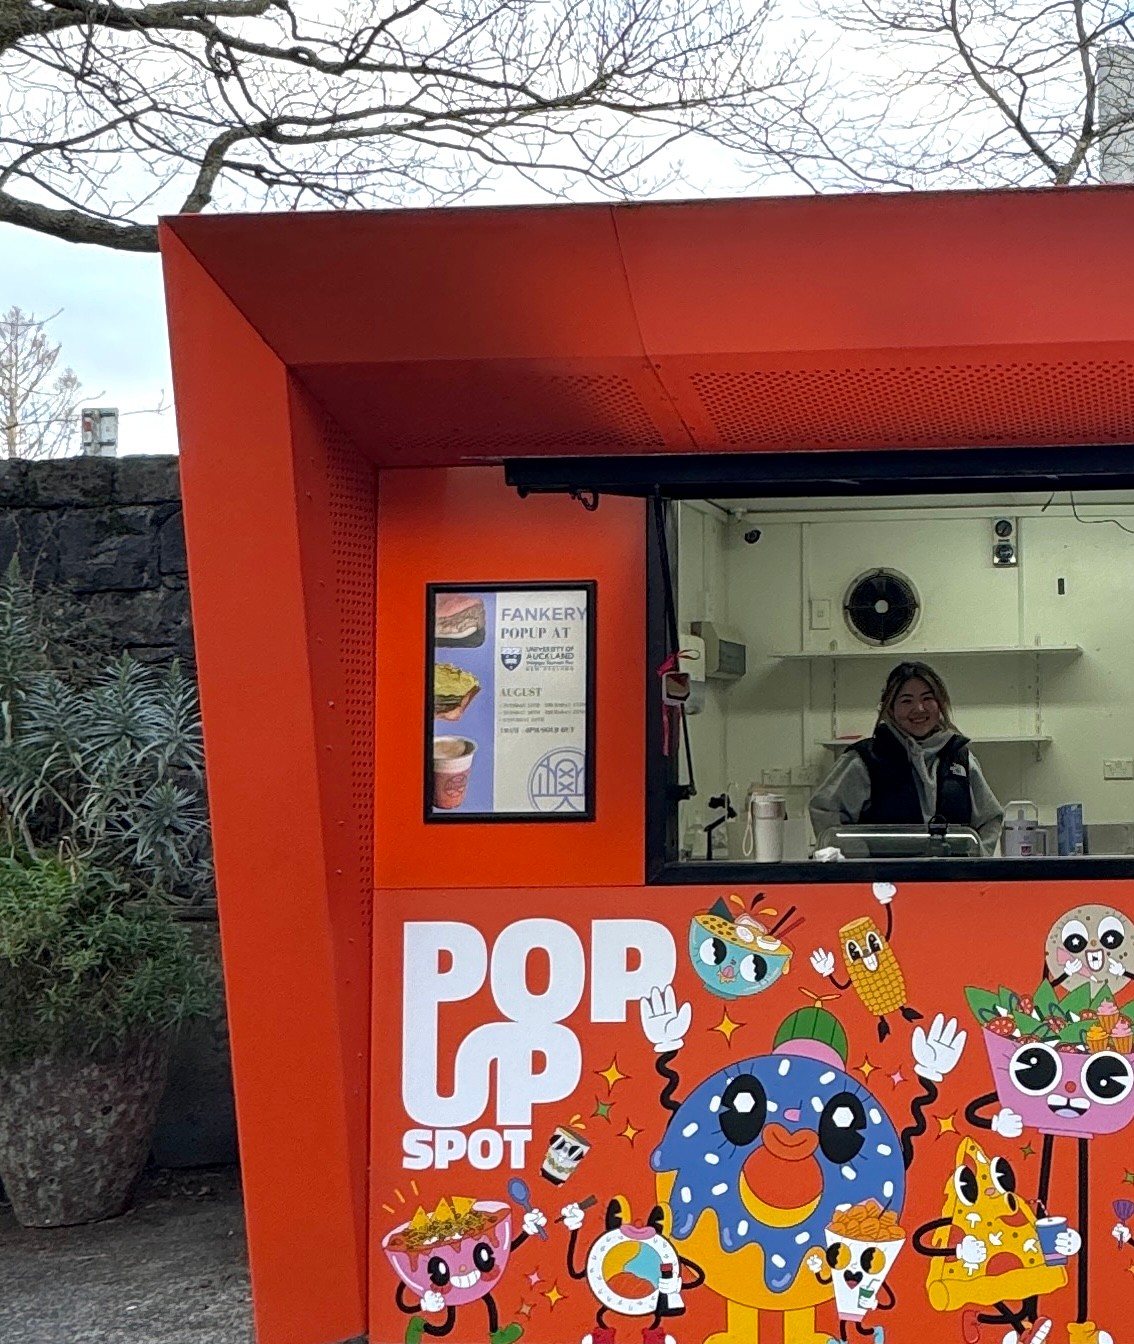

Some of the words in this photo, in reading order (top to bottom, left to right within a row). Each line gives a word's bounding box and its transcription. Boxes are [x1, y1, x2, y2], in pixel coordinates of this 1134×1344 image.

[501, 607, 587, 622] FANKERY
[500, 627, 546, 639] POPUP
[551, 626, 571, 639] AT
[501, 687, 542, 697] AUGUST
[403, 917, 677, 1023] POP
[402, 1129, 532, 1170] SPOT
